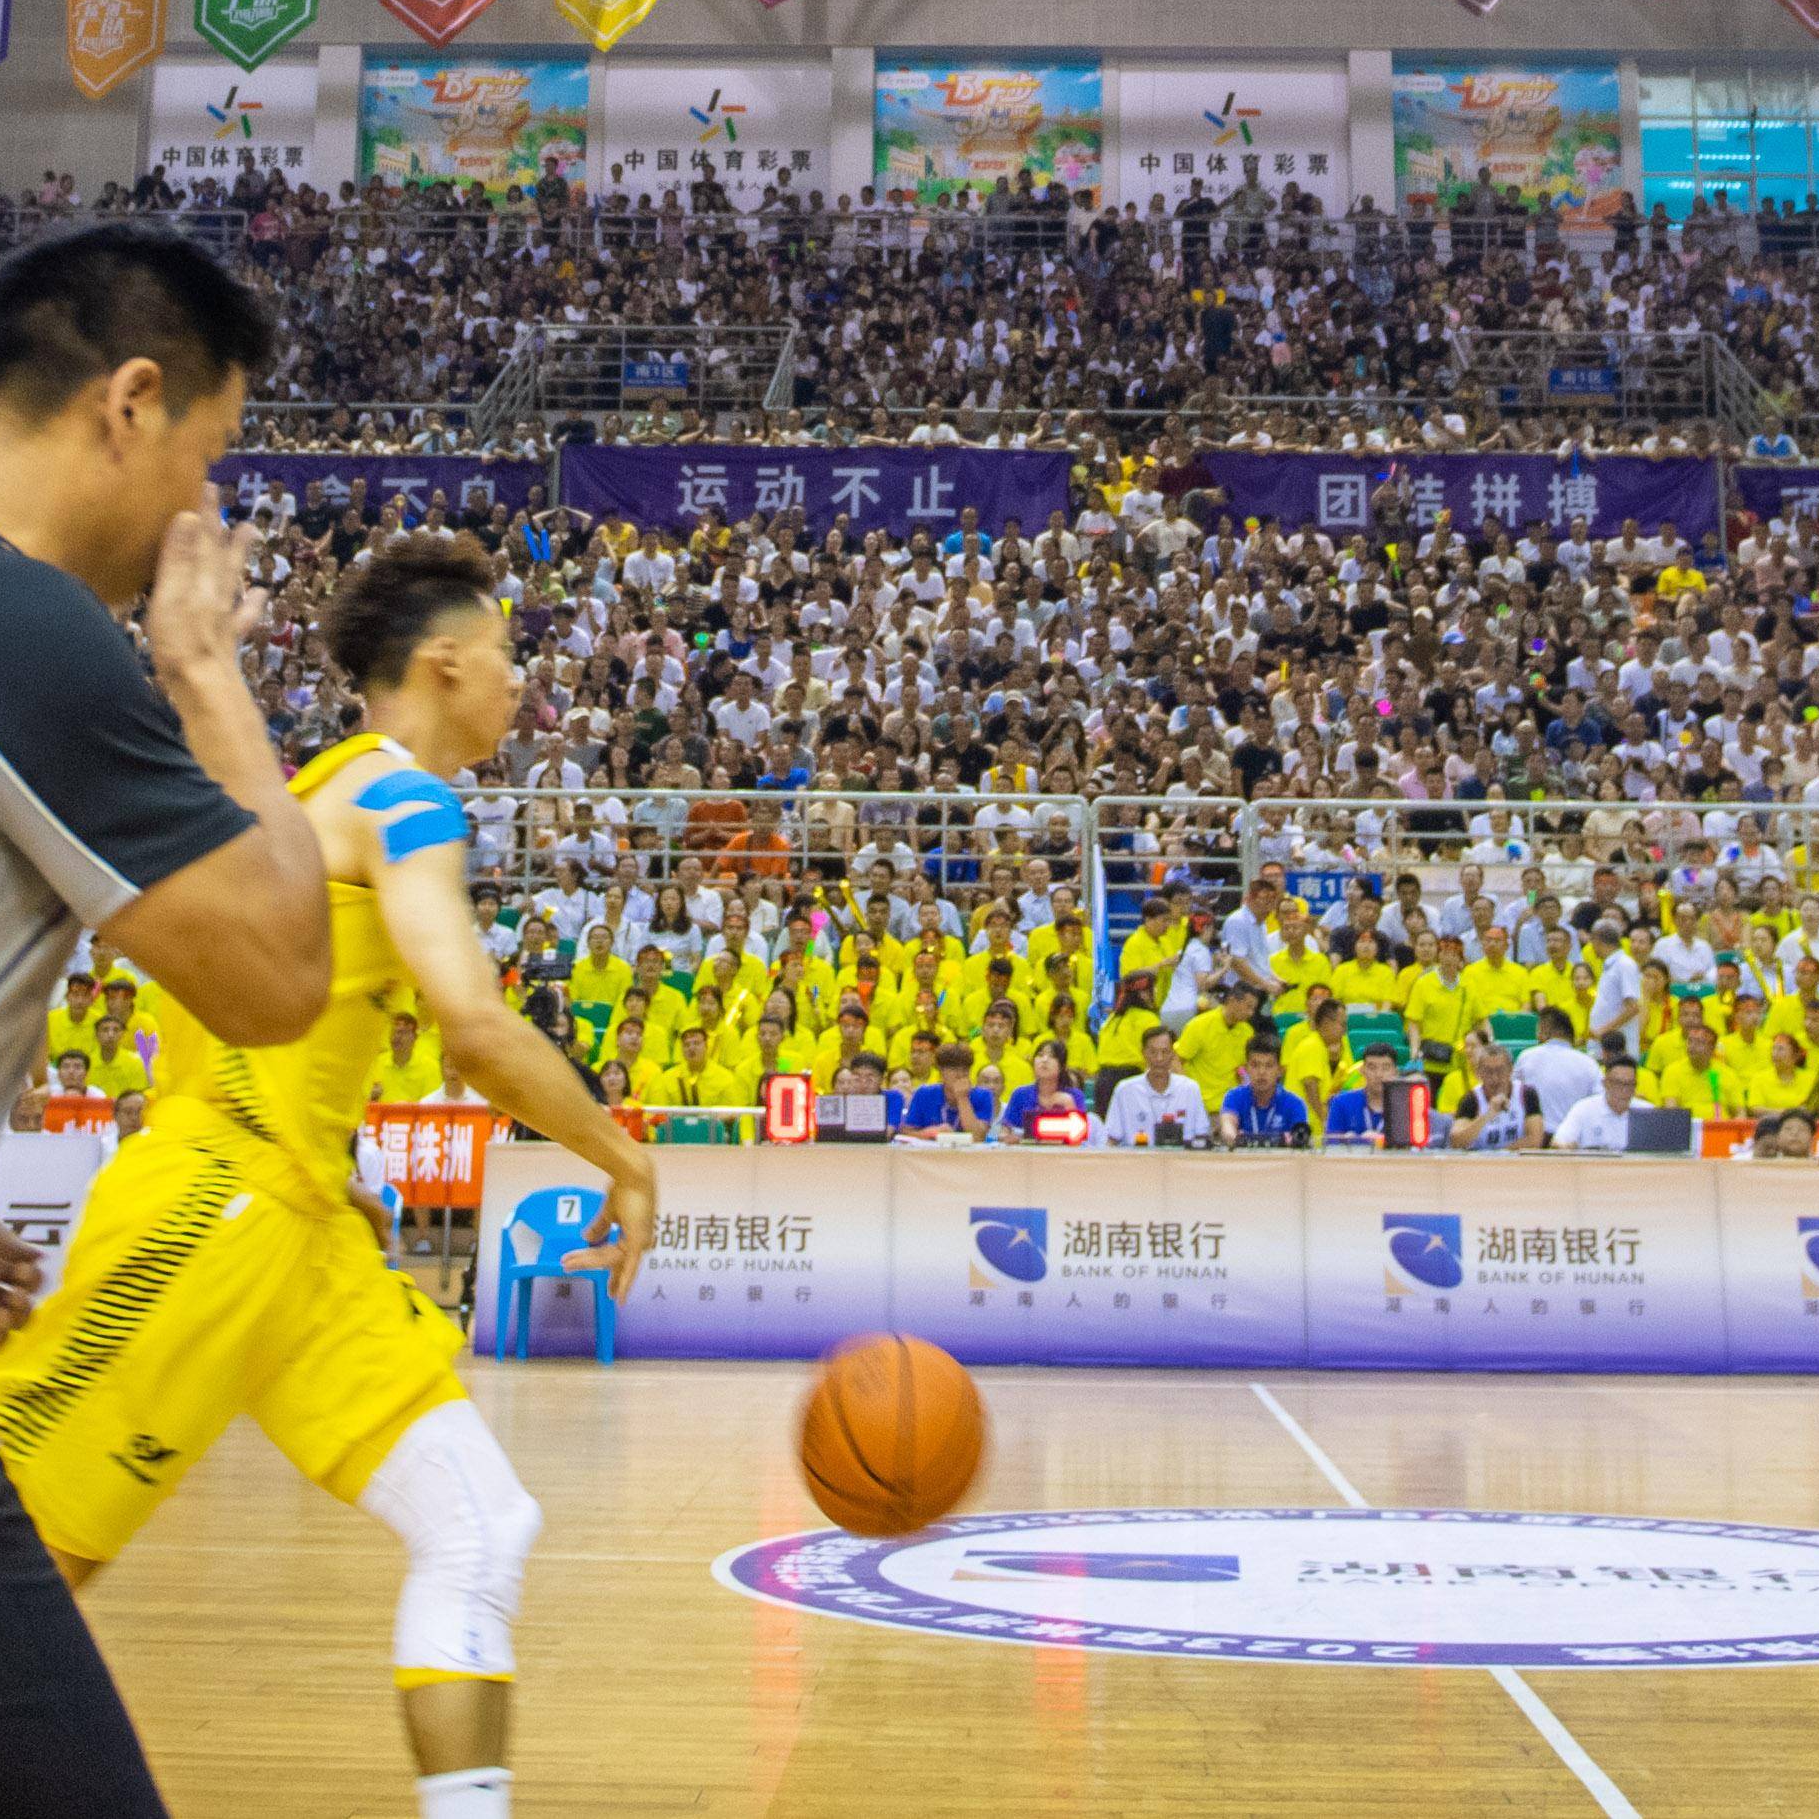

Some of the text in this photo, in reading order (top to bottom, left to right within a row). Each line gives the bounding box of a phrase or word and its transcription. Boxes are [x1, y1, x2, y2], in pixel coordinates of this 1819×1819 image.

[162, 145, 304, 169] 中国体育彩票
[624, 149, 812, 172] 中国体育彩票
[1140, 152, 1329, 176] 中国体育彩票
[677, 465, 956, 518] 运动不止
[1318, 473, 1599, 526] 团结拼搏
[769, 1076, 810, 1141] 0
[359, 1120, 474, 1183] 福株洲
[562, 1199, 577, 1219] 7
[654, 1214, 812, 1253] 湖南银行
[1063, 1221, 1226, 1260] 湖南银行
[1477, 1227, 1642, 1265] 湖南银行
[649, 1258, 813, 1272] BANK OF HUNAN
[1062, 1265, 1228, 1280] BANK OF HUNAN
[1477, 1271, 1646, 1285] BANK OF HUNAN
